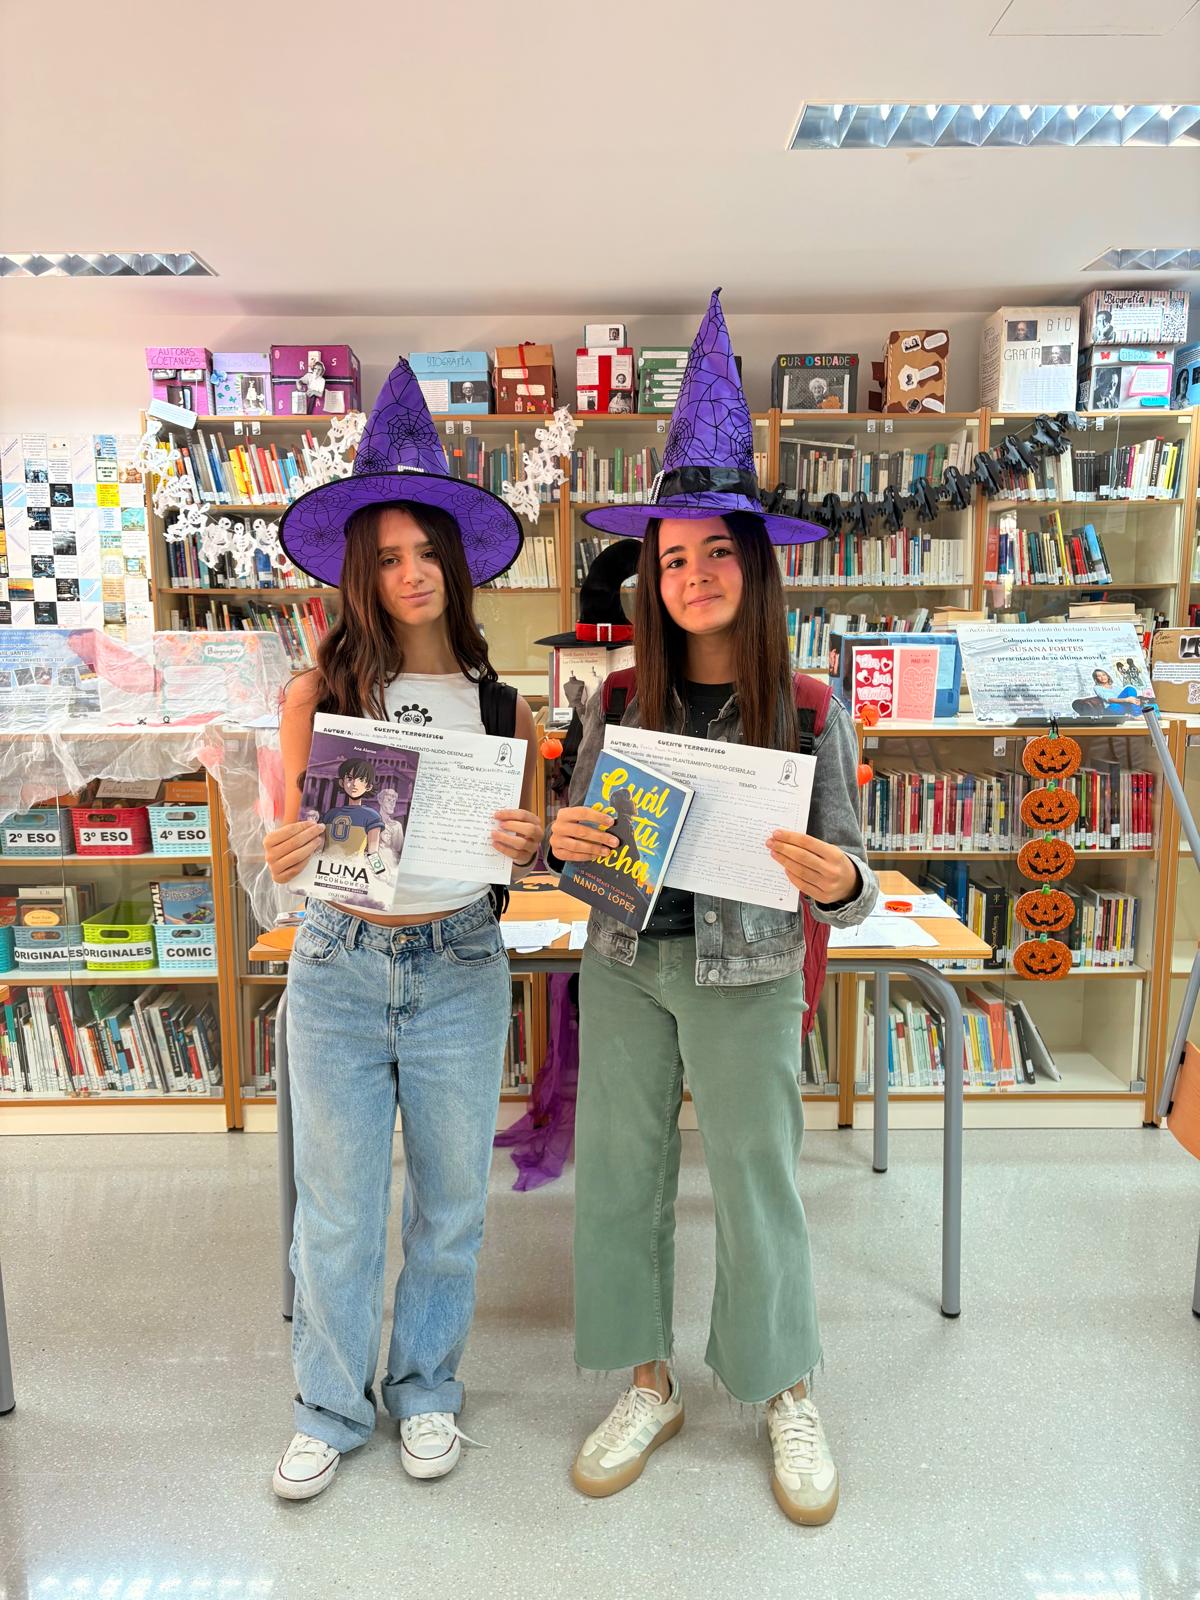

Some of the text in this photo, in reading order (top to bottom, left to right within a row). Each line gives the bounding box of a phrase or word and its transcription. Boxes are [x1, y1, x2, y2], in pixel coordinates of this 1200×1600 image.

[1105, 293, 1145, 309] Biografía
[158, 347, 196, 357] AUTORAS
[780, 355, 857, 367] CURIOSIDADES
[1009, 645, 1047, 653] SUSANA
[374, 726, 400, 735] CUENTO
[657, 739, 683, 748] CUENTO
[27, 833, 56, 843] ESO
[101, 831, 128, 842] ESO
[178, 830, 206, 841] ESO
[316, 860, 369, 884] LUNA
[573, 874, 637, 914] NANDO LÓPEZ
[14, 949, 84, 960] ORIGINALES
[84, 946, 152, 959] ORIGINALES
[166, 947, 212, 958] COMIC
